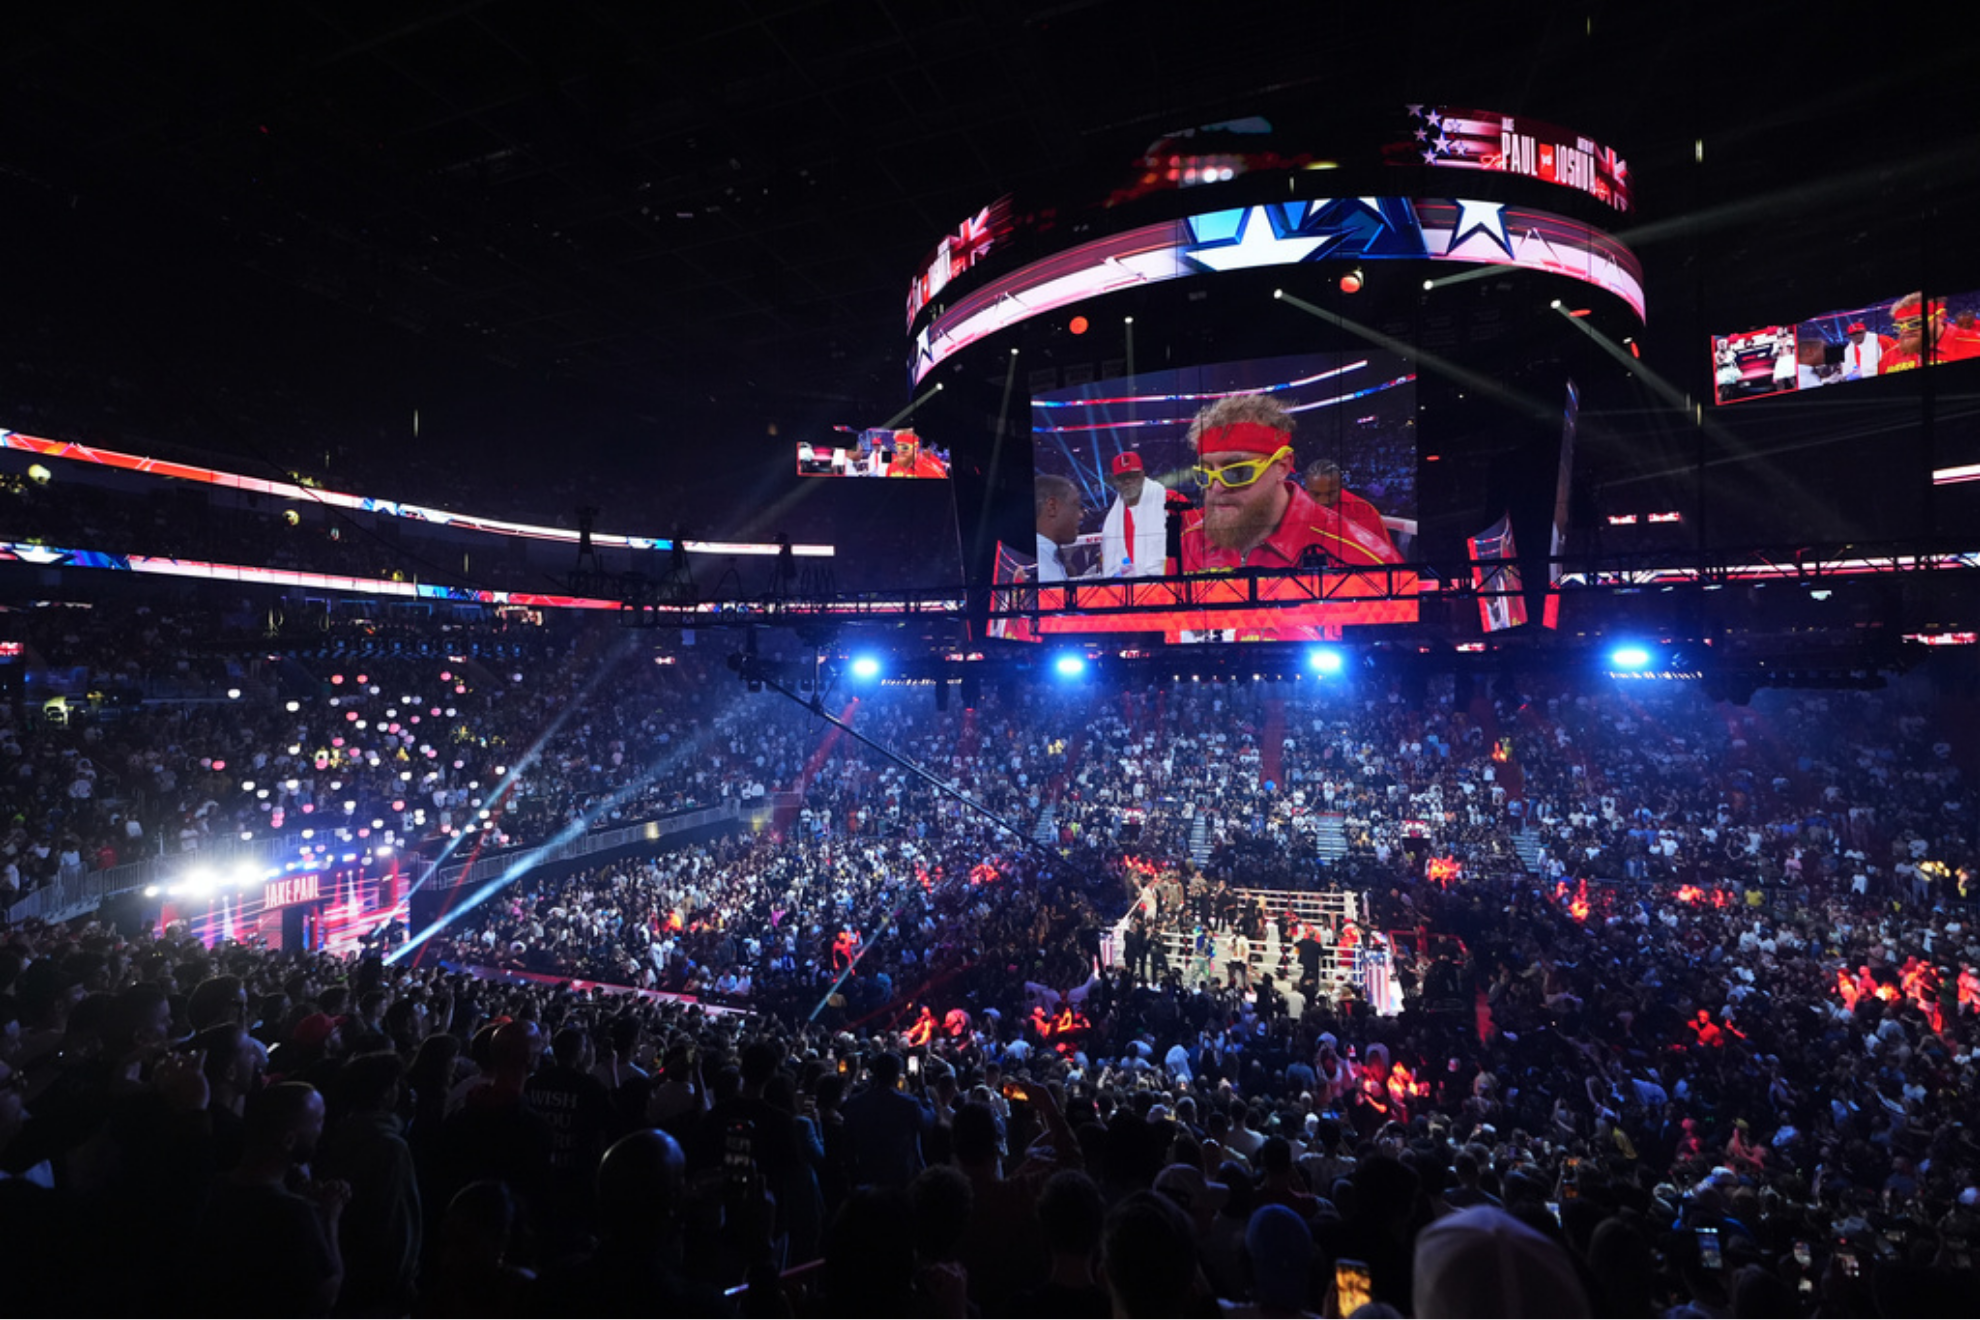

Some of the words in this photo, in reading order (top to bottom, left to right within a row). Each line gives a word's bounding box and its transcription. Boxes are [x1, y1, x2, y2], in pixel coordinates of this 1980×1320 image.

[1502, 131, 1538, 176] PAUL
[263, 880, 292, 910] JAKE
[293, 875, 320, 902] PAUL
[530, 1090, 579, 1110] WISH
